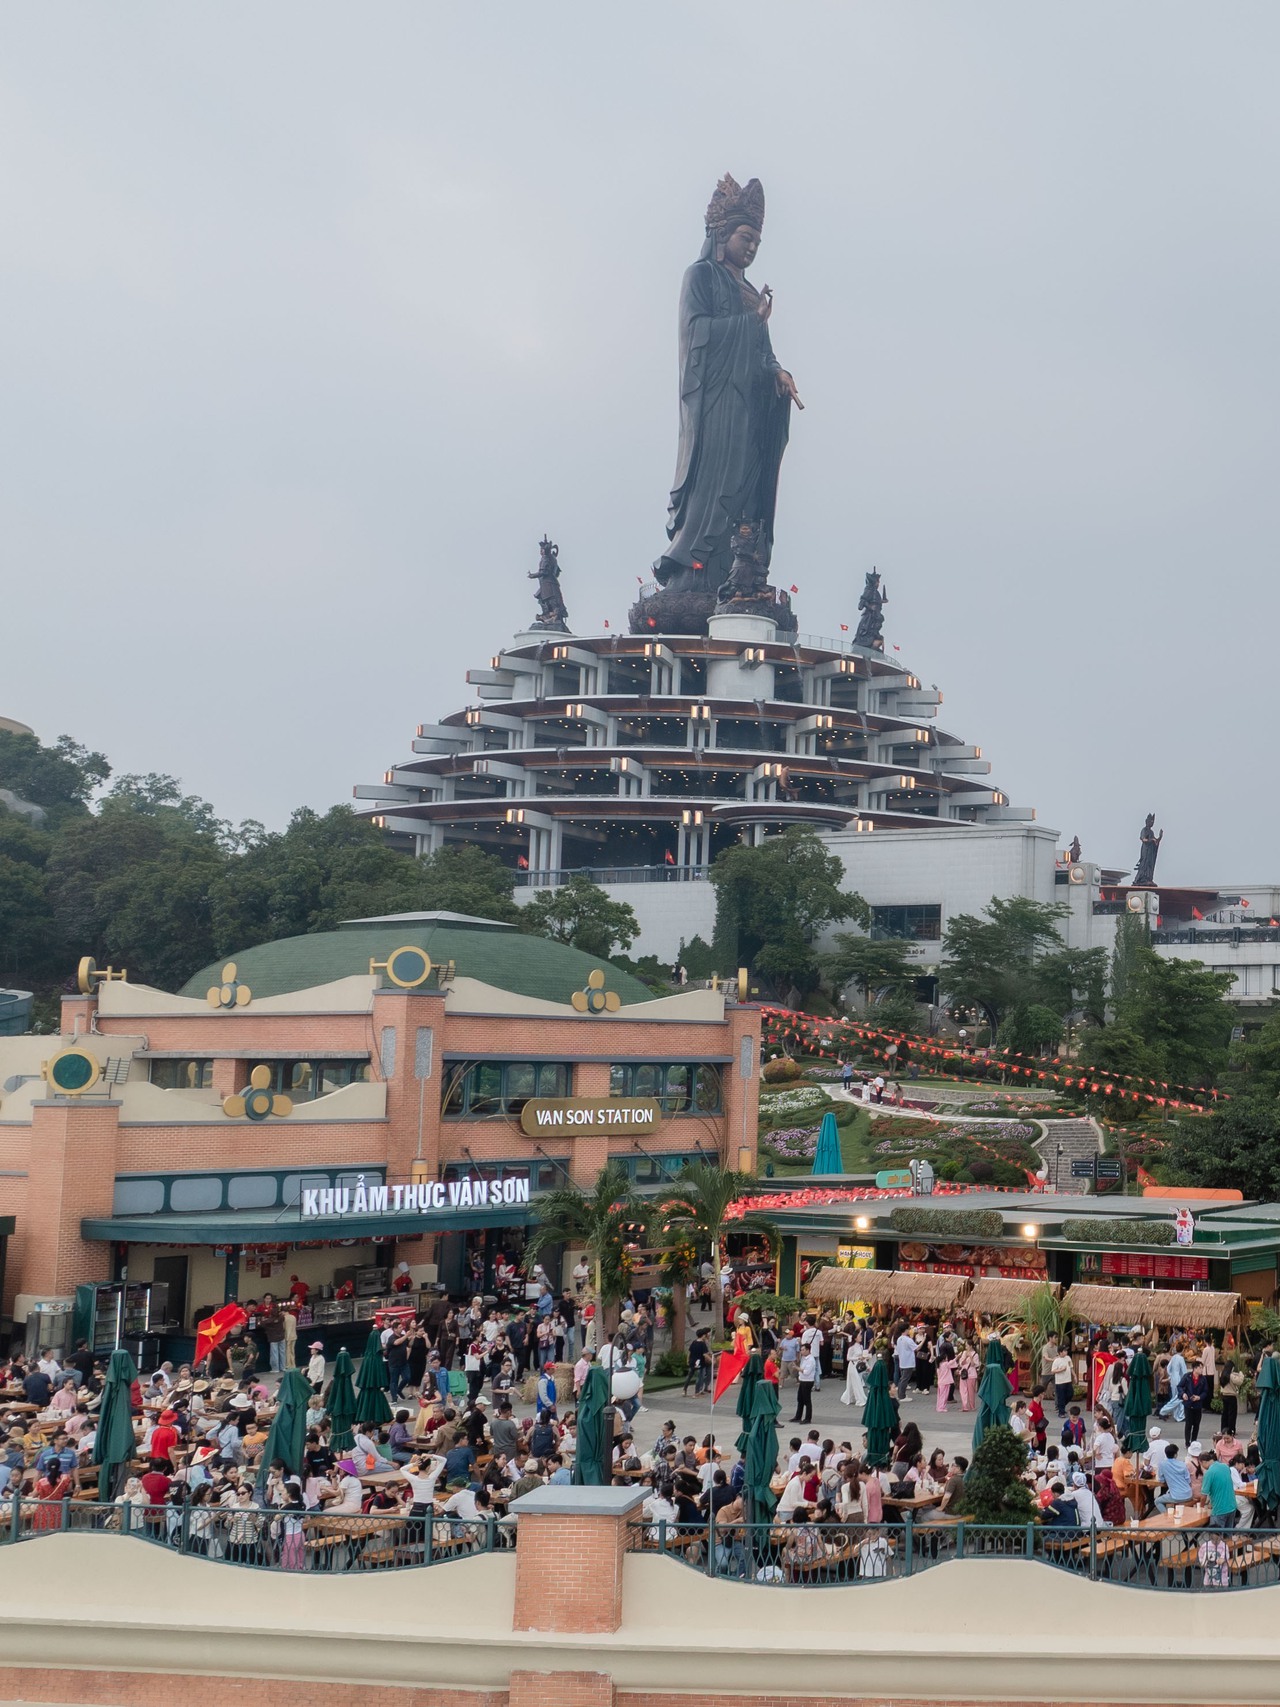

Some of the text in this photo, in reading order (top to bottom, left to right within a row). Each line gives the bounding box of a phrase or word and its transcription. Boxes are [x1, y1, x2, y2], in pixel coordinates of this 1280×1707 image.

[536, 1108, 653, 1125] VAN SON STATION
[302, 1174, 529, 1216] KHU ẨM THỰC VÂN SƠN
